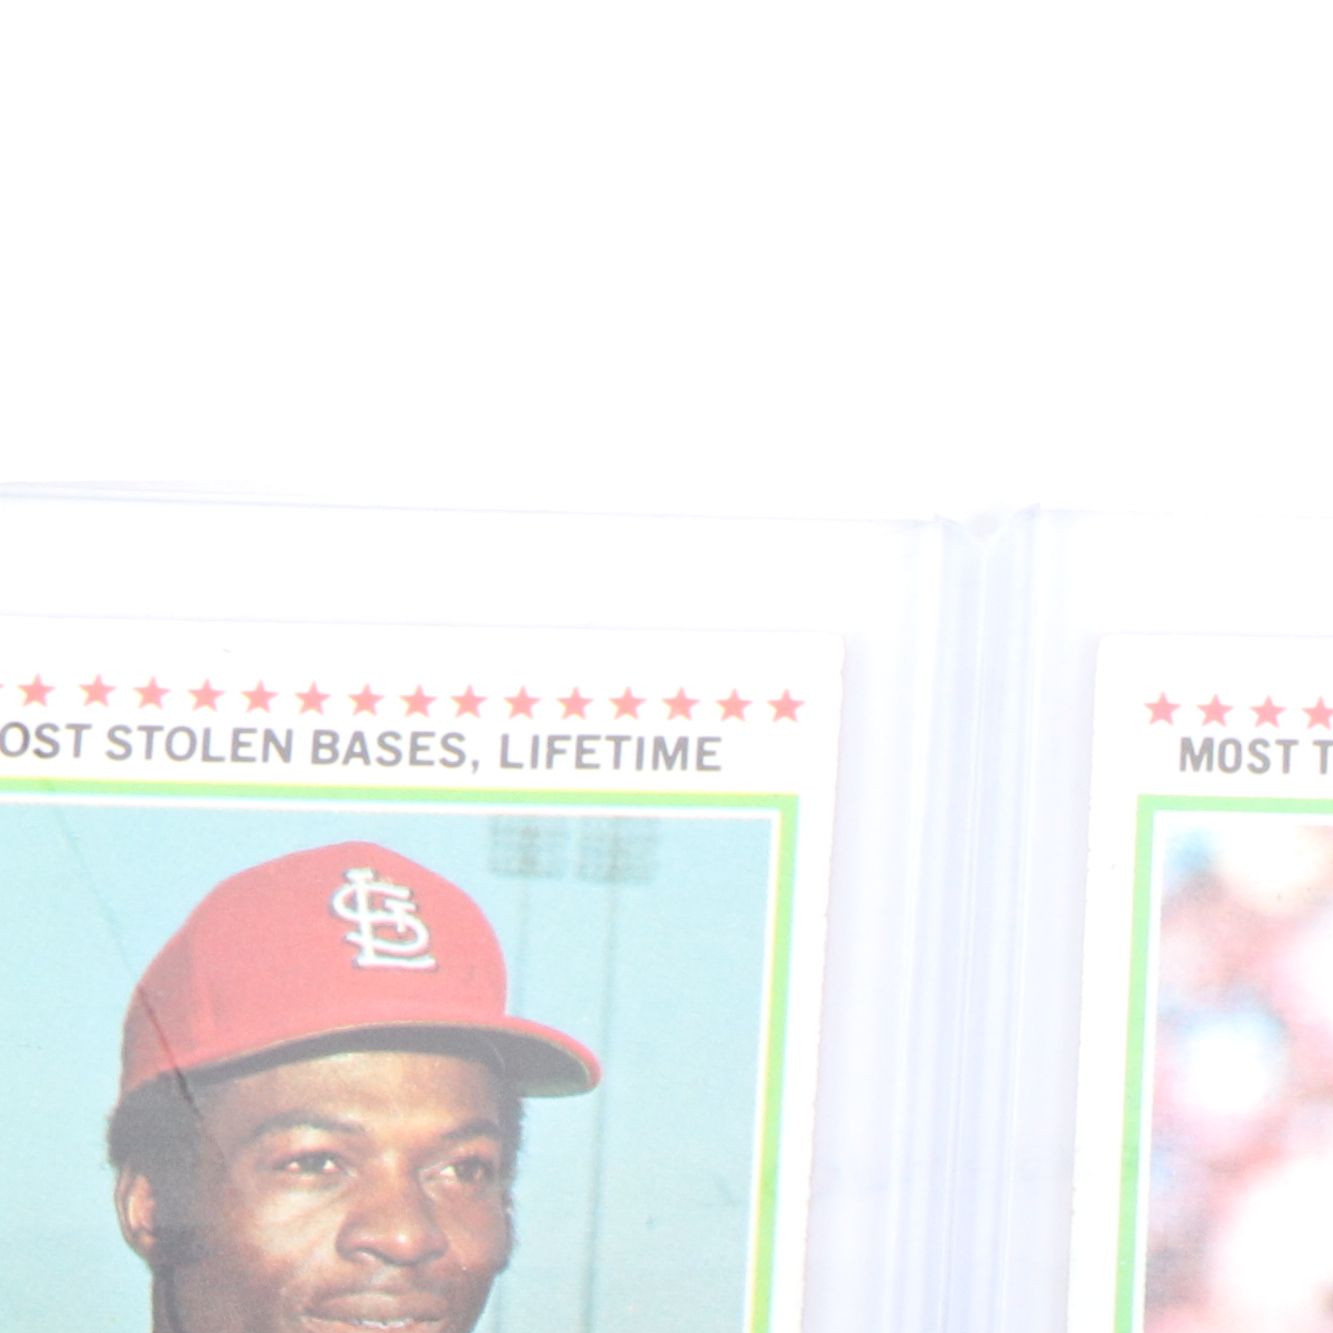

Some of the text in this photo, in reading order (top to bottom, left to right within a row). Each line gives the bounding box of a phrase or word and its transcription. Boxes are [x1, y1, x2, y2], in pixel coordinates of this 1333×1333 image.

[106, 725, 293, 763] STOLEN
[311, 729, 479, 773] BASES,
[500, 734, 722, 772] LIFETIME
[1180, 737, 1299, 775] MOST
